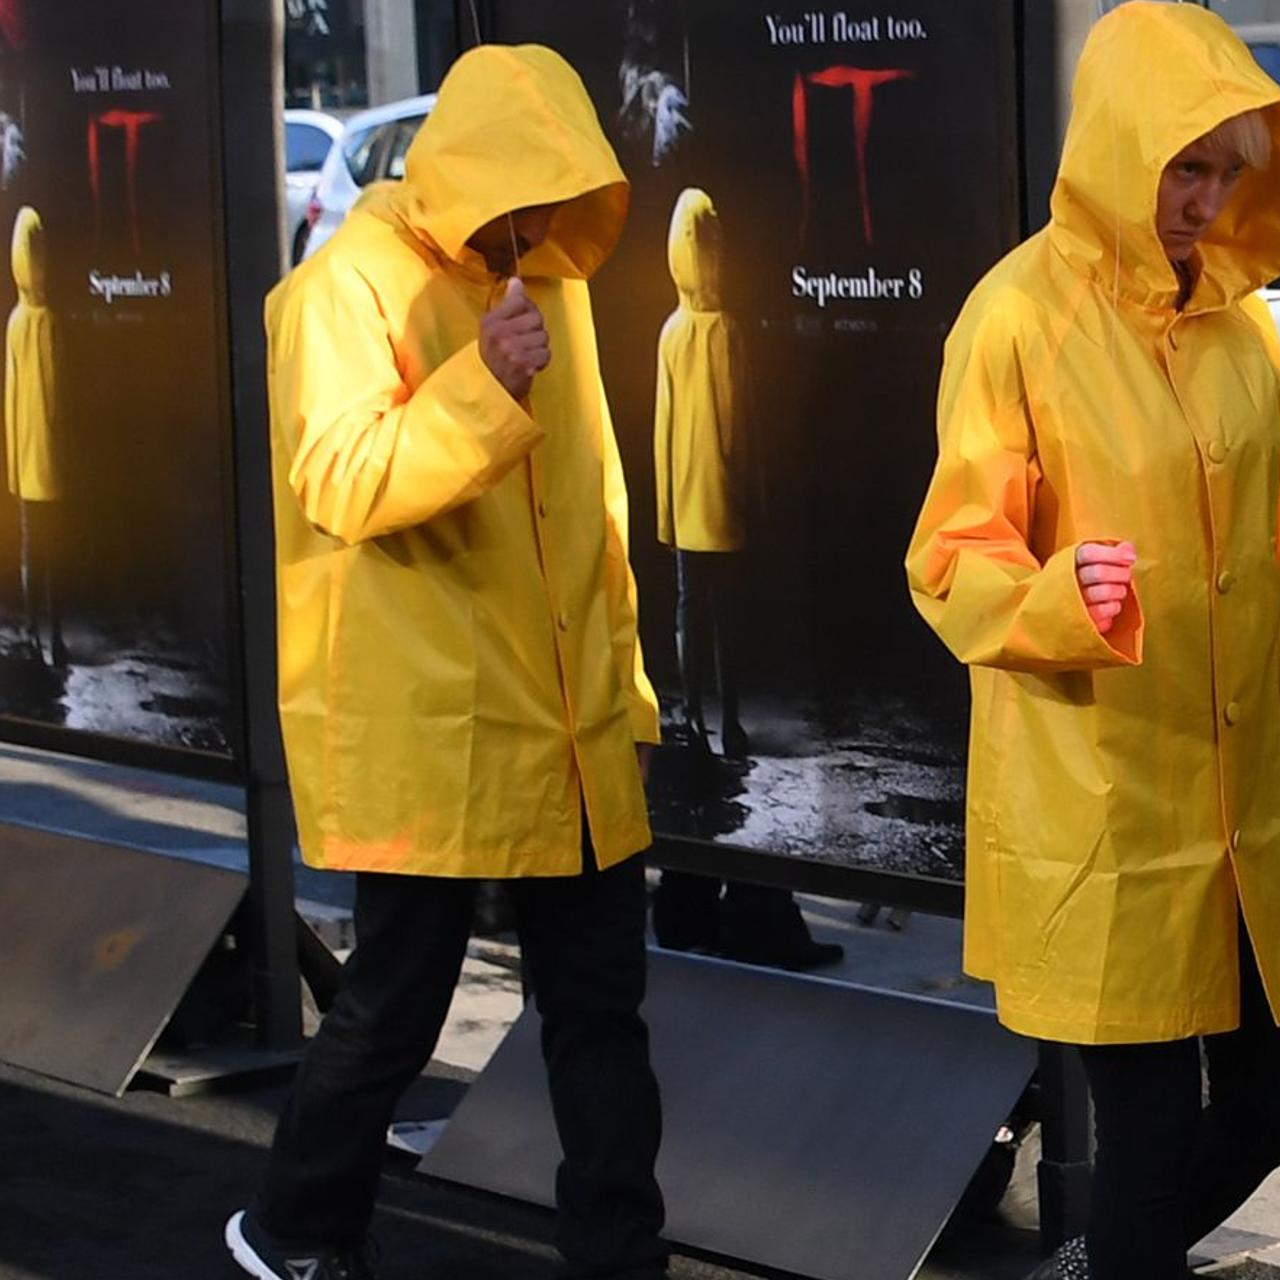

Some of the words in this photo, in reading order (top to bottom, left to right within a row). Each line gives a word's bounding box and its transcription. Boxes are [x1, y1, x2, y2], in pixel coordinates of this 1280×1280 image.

[832, 12, 880, 43] float
[887, 16, 927, 40] too.
[792, 66, 915, 246] IT
[87, 109, 163, 256] IT
[88, 270, 158, 304] September
[160, 272, 171, 296] 8
[791, 266, 905, 307] September
[908, 268, 923, 298] 8
